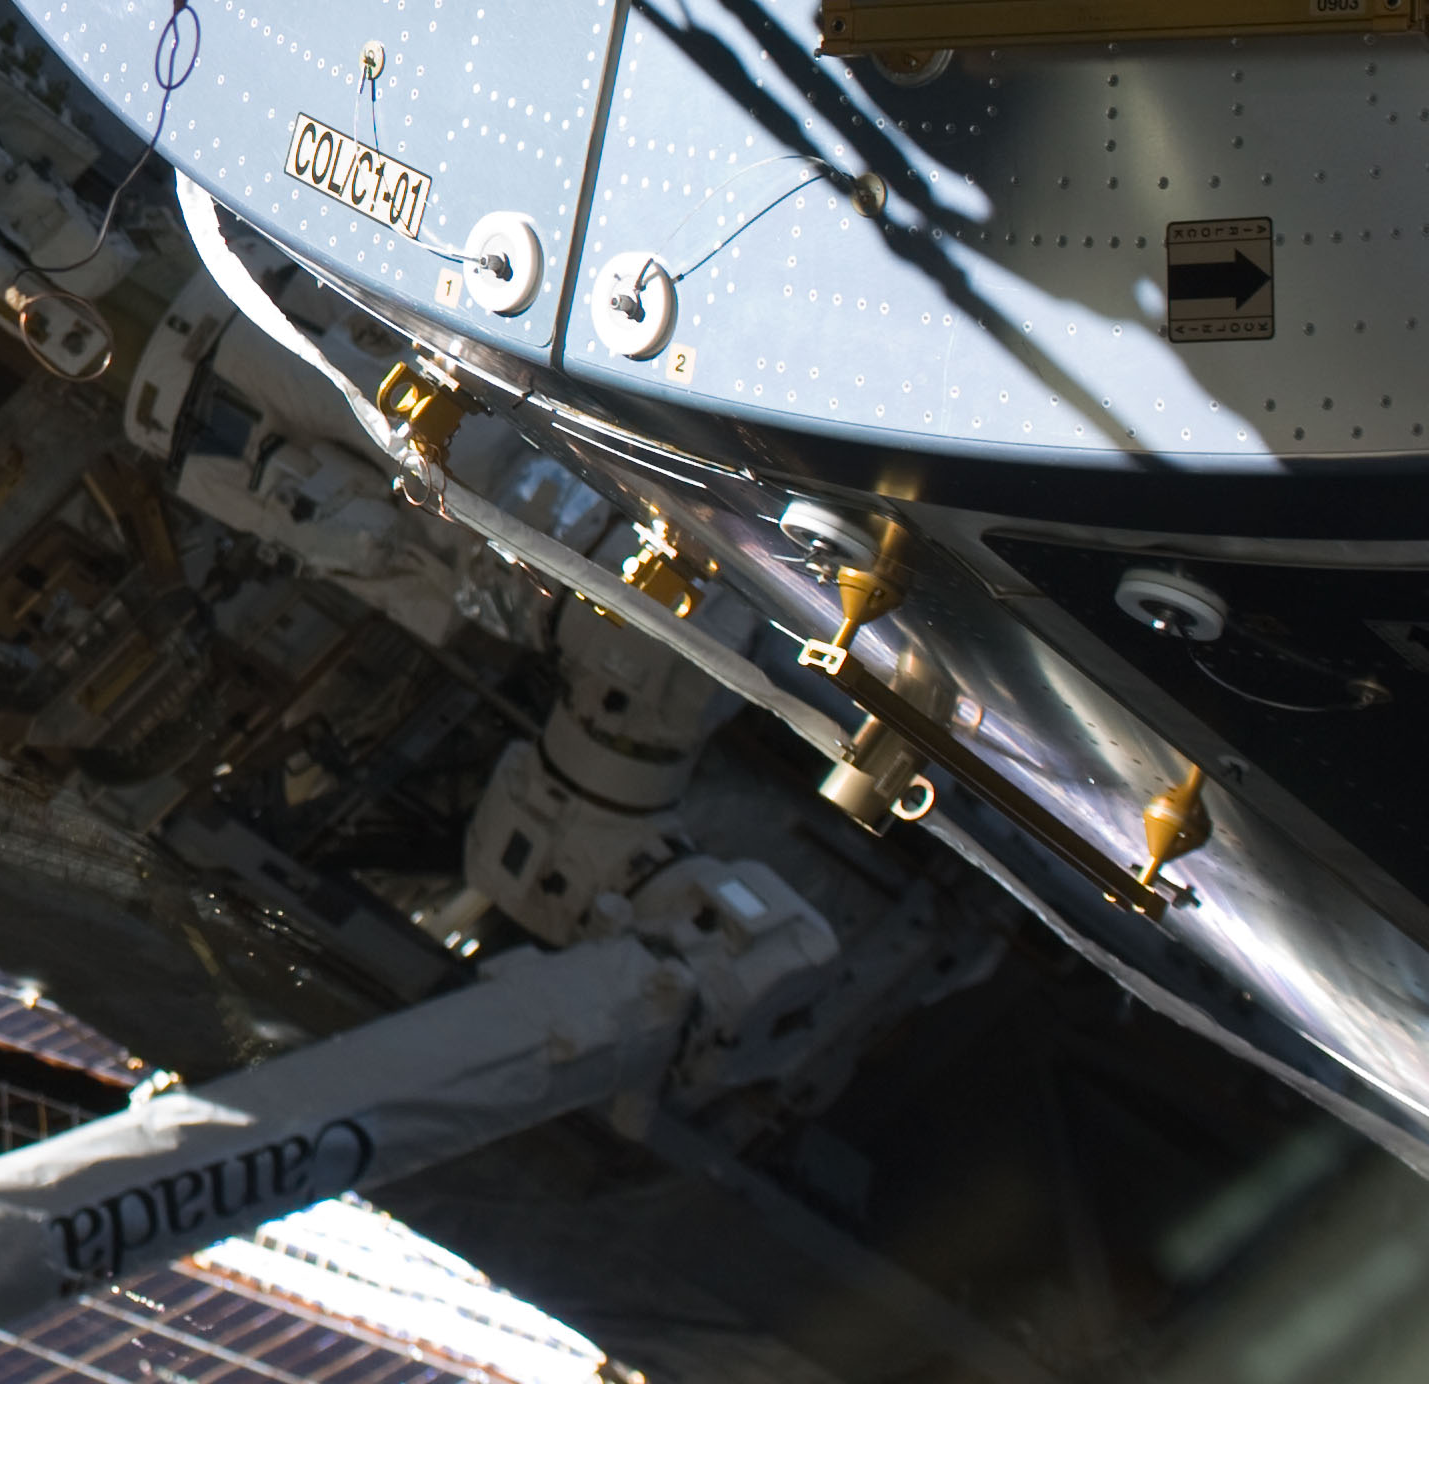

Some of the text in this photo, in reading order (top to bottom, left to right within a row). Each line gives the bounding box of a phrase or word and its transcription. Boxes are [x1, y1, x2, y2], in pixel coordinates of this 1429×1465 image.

[294, 122, 423, 231] COL/C1-01
[674, 353, 686, 373] 2
[50, 1118, 374, 1276] Canada
